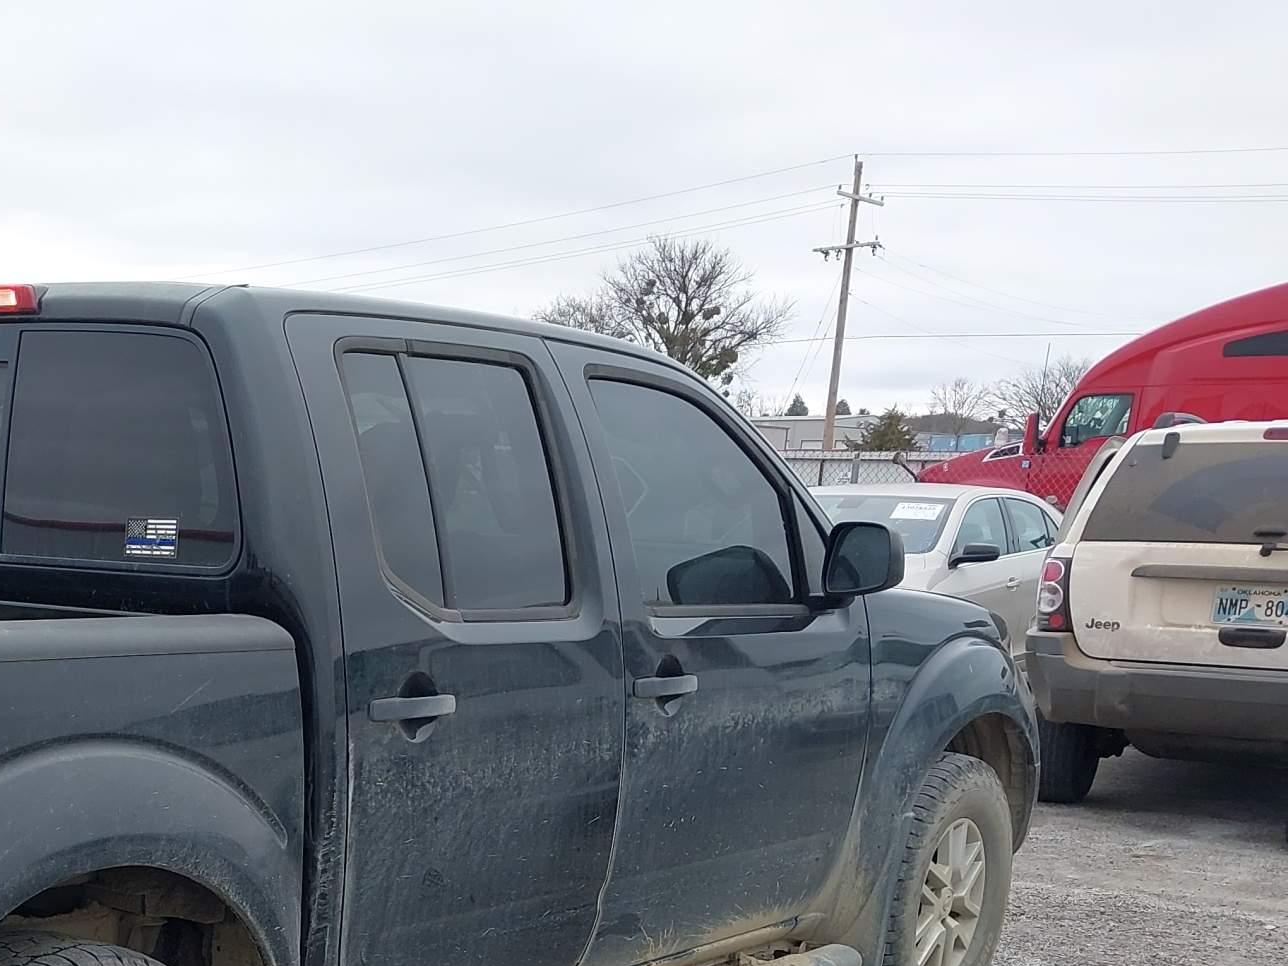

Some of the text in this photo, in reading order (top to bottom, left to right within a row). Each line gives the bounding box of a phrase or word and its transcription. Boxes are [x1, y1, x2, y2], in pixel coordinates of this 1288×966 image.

[1237, 588, 1282, 597] OKLAHOMA
[1217, 597, 1288, 618] NMP-80
[1085, 617, 1121, 632] Jeep
